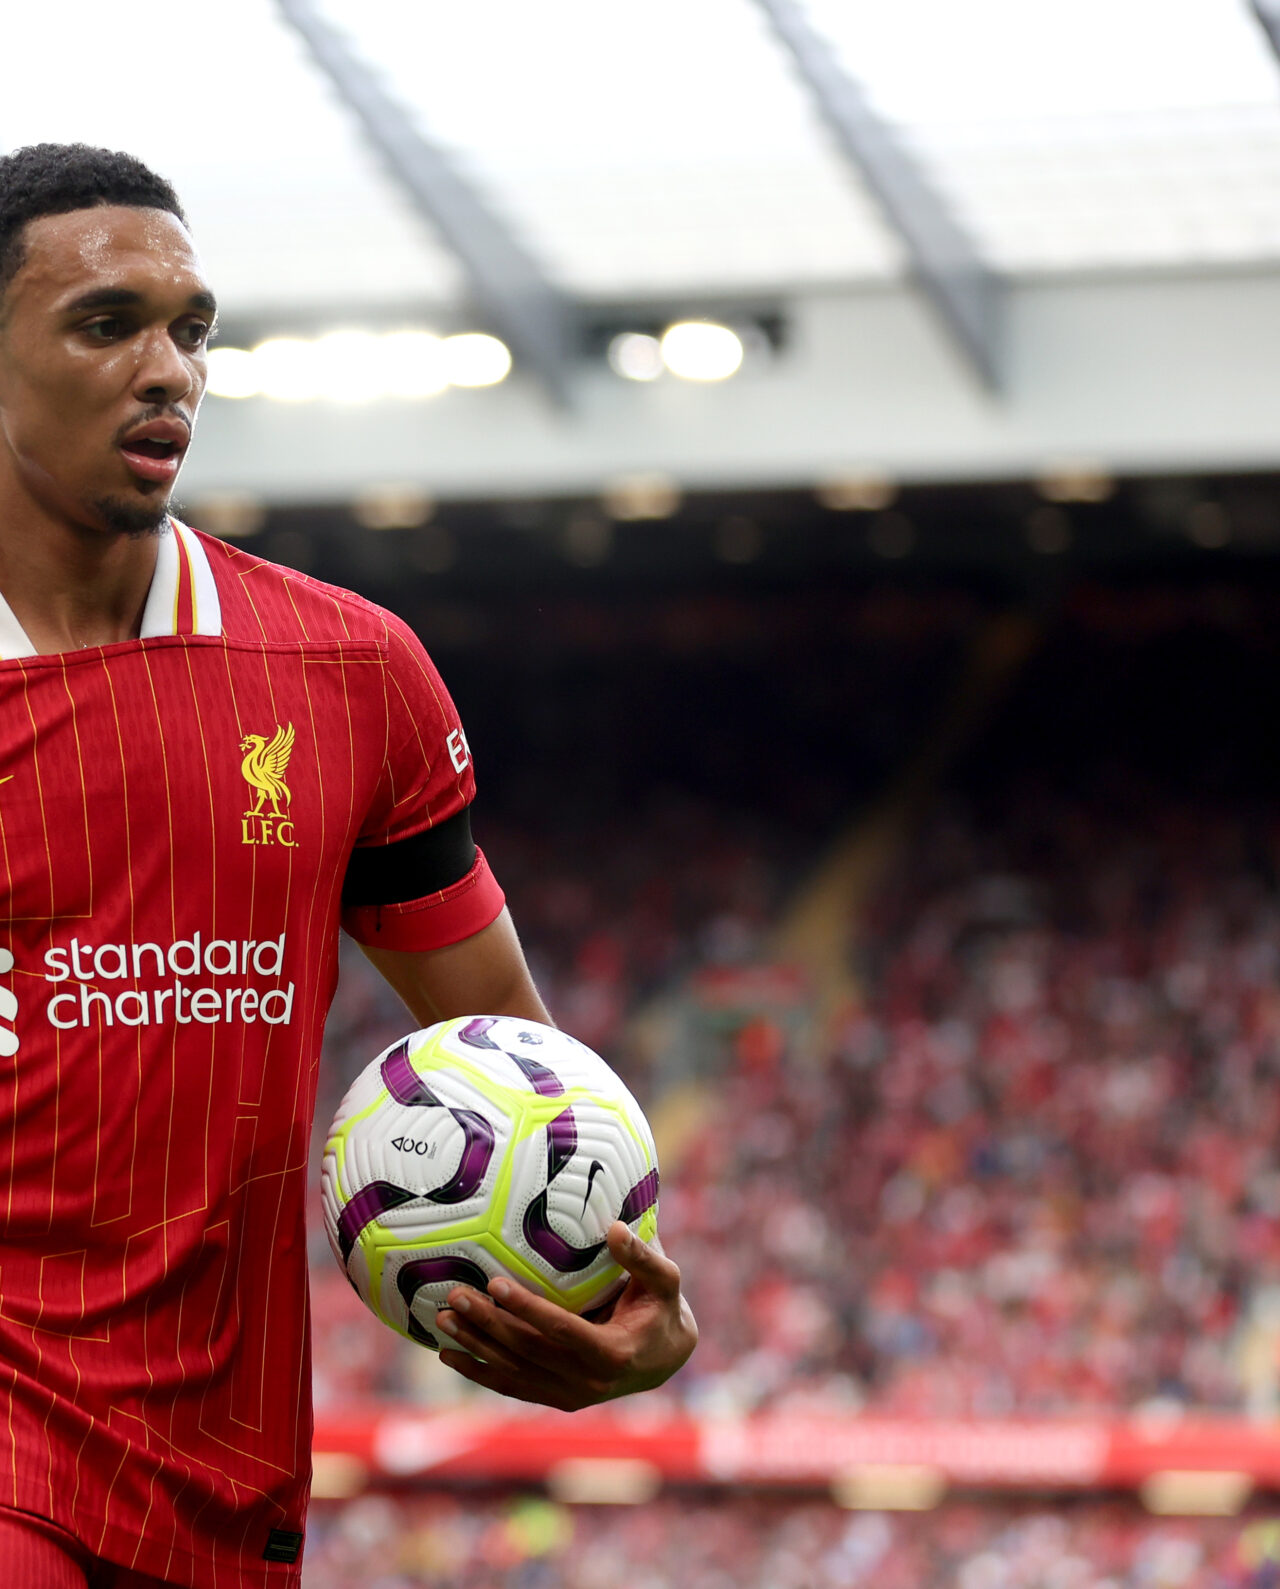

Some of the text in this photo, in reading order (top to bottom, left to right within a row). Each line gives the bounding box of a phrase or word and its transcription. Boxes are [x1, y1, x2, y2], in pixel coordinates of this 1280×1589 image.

[241, 819, 299, 848] L.F.C.
[44, 930, 286, 982] standard
[45, 979, 295, 1029] chartered
